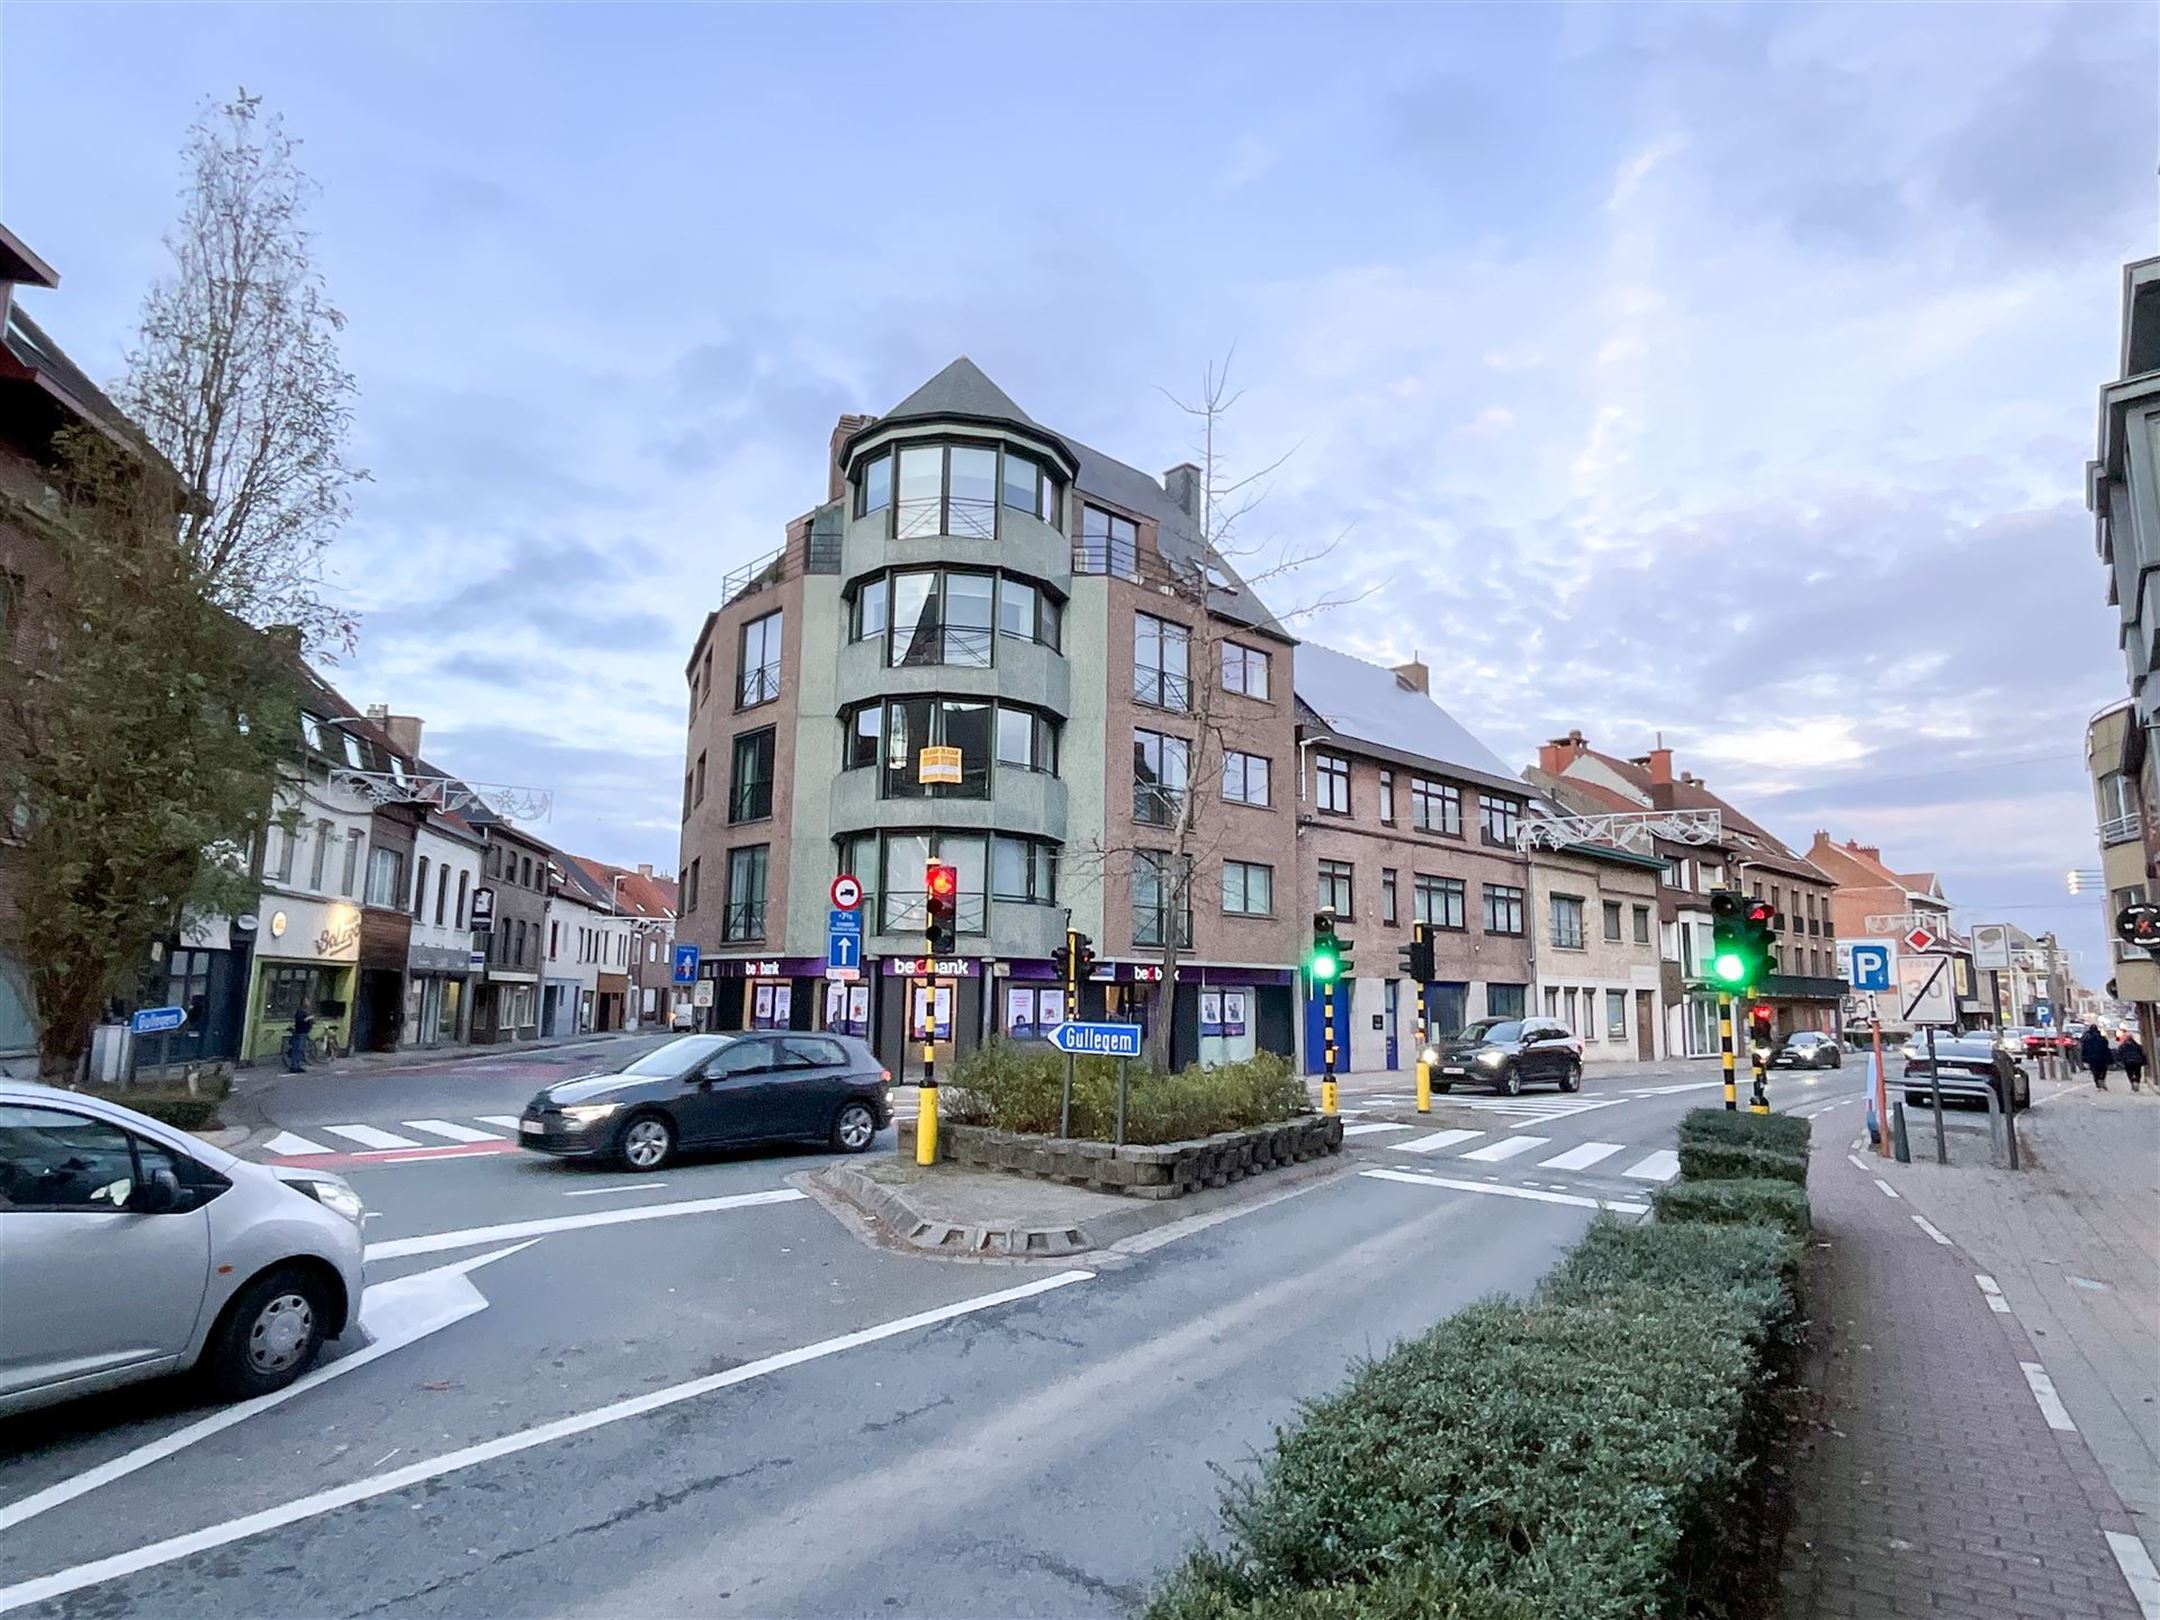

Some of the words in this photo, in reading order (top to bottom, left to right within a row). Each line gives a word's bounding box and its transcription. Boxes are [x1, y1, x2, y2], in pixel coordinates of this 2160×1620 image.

[893, 958, 969, 975] beoank
[1857, 952, 1882, 984] P
[1907, 980, 1942, 999] 30
[2036, 1006, 2049, 1021] P
[1066, 1027, 1132, 1054] Gullegem
